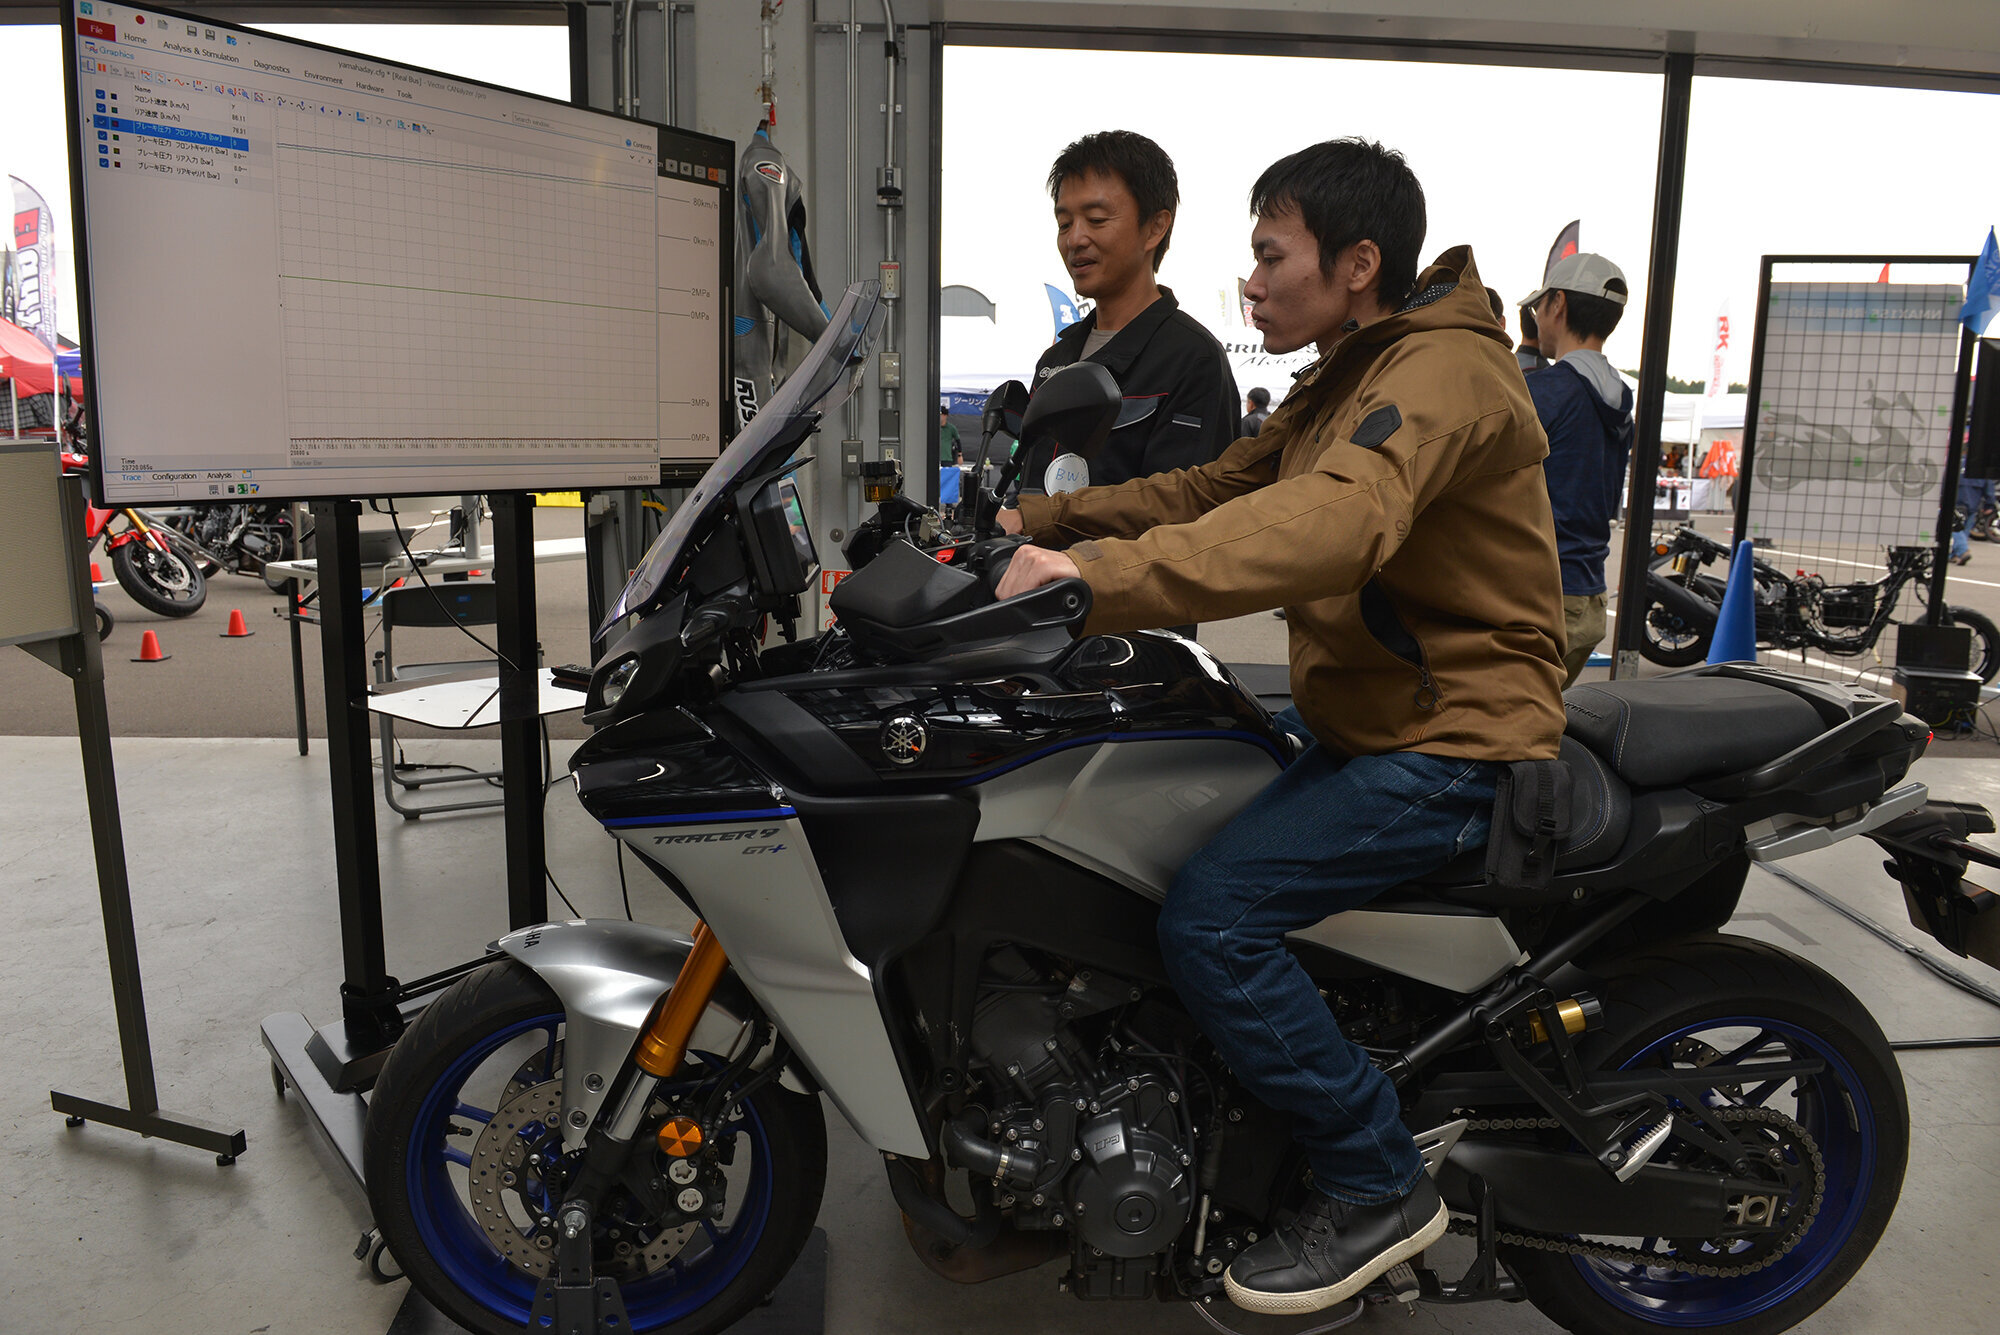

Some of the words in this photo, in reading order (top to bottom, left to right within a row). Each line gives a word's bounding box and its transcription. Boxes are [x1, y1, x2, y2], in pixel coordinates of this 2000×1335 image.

[90, 24, 104, 35] File
[124, 32, 147, 44] Home
[99, 46, 135, 60] Graphics
[163, 41, 192, 54] Analysis
[253, 59, 290, 74] Diagnostics
[304, 70, 343, 85] Environment
[338, 60, 385, 78] yamahaday.cfg
[408, 74, 422, 86] Bus]
[134, 85, 151, 94] Name
[356, 82, 384, 93] Hardware
[396, 90, 412, 99] Tools
[134, 95, 168, 107] フロント速度
[134, 108, 158, 119] リア速度
[135, 122, 172, 135] ブレーキ圧力
[136, 135, 172, 148] ブレーキ圧力
[137, 149, 173, 161] ブレーキ圧力
[138, 162, 173, 174] ブレーキ圧力
[693, 197, 718, 210] 80km/h
[693, 236, 715, 247] 0km/h
[691, 288, 711, 298] 2MPa
[690, 311, 710, 321] 0MPa
[691, 398, 710, 407] 3MPa
[691, 434, 710, 442] 0MPa
[152, 473, 197, 481] Configuration
[653, 829, 758, 844] TRACER
[760, 828, 780, 839] 9
[742, 844, 787, 854] GT+
